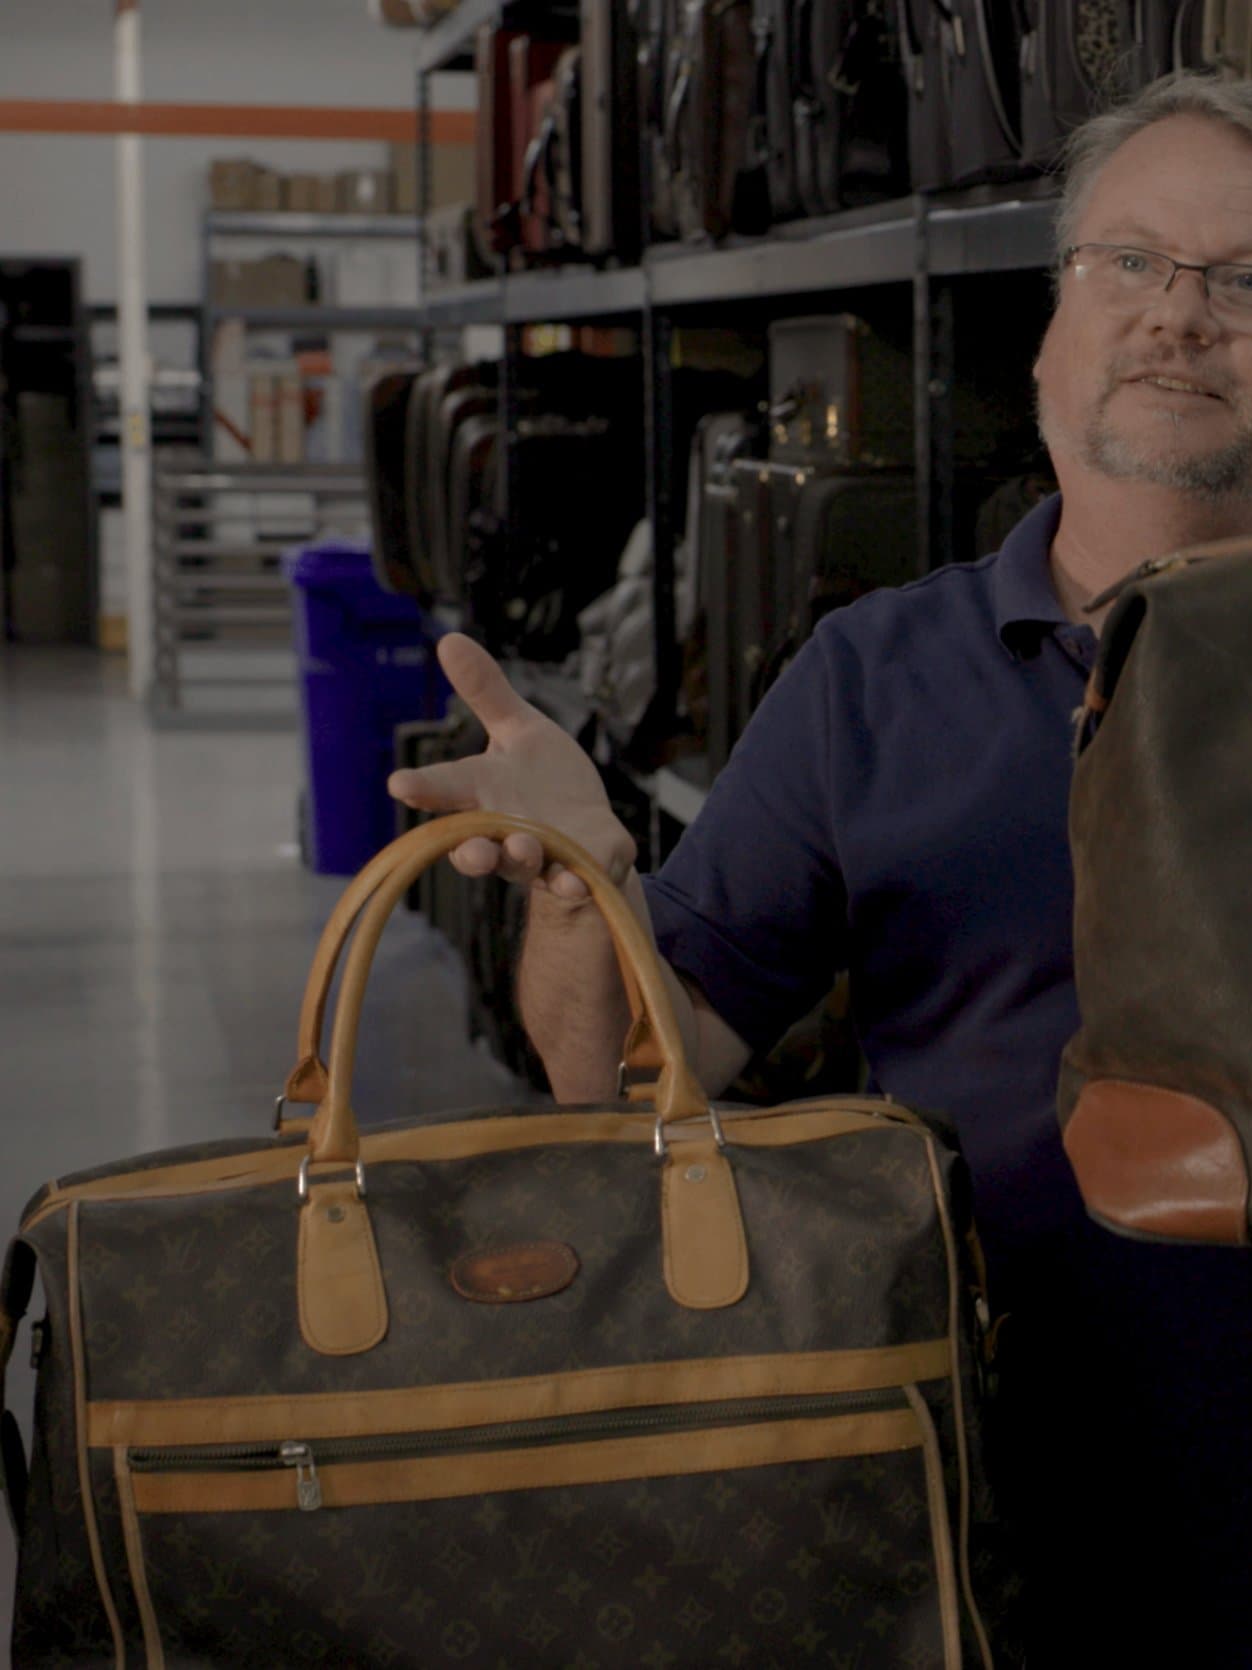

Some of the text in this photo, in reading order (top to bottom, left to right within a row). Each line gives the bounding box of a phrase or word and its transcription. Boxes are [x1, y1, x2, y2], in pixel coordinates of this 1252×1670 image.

[664, 1514, 705, 1567] LV
[815, 1495, 859, 1547] LV
[352, 1547, 400, 1600] LV
[510, 1528, 553, 1581] LV
